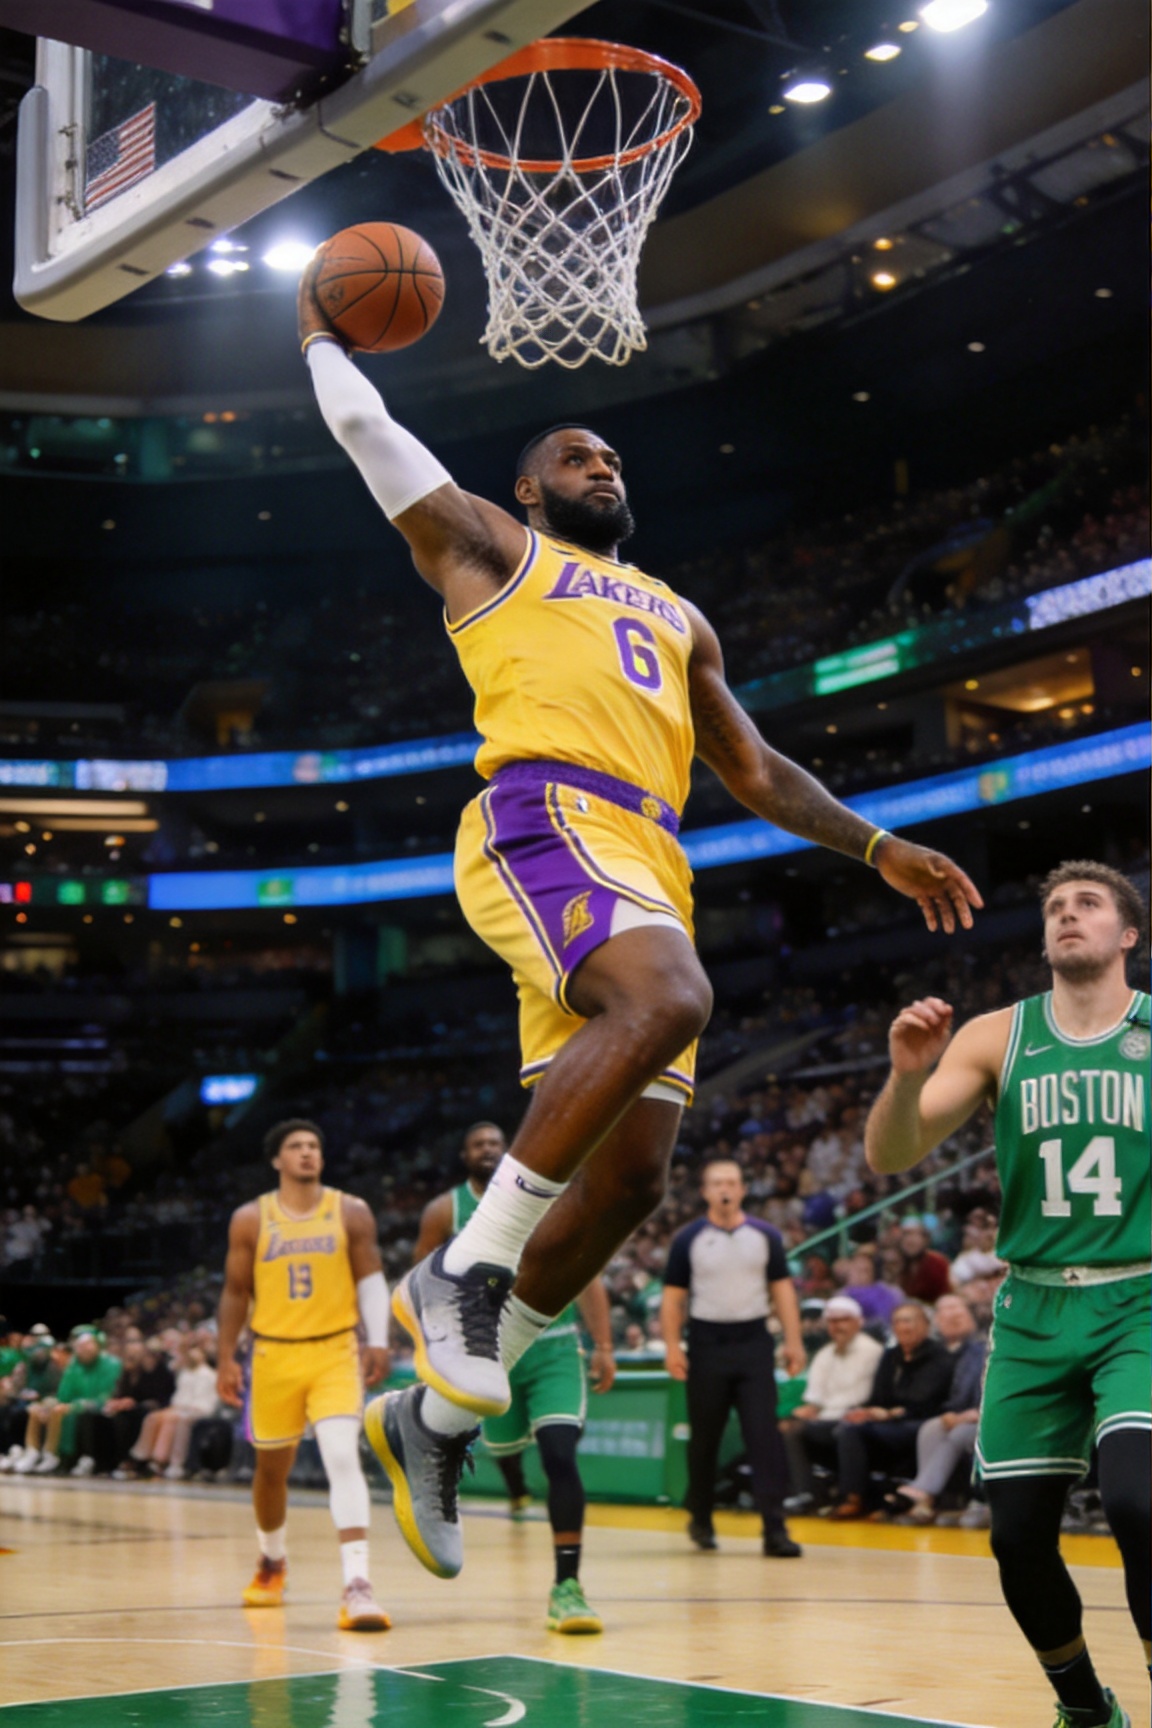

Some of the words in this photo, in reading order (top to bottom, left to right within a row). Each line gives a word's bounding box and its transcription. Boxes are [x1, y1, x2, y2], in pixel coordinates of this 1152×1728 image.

[612, 616, 662, 691] 6
[1020, 1069, 1145, 1135] BOSTON
[1038, 1136, 1123, 1217] 14
